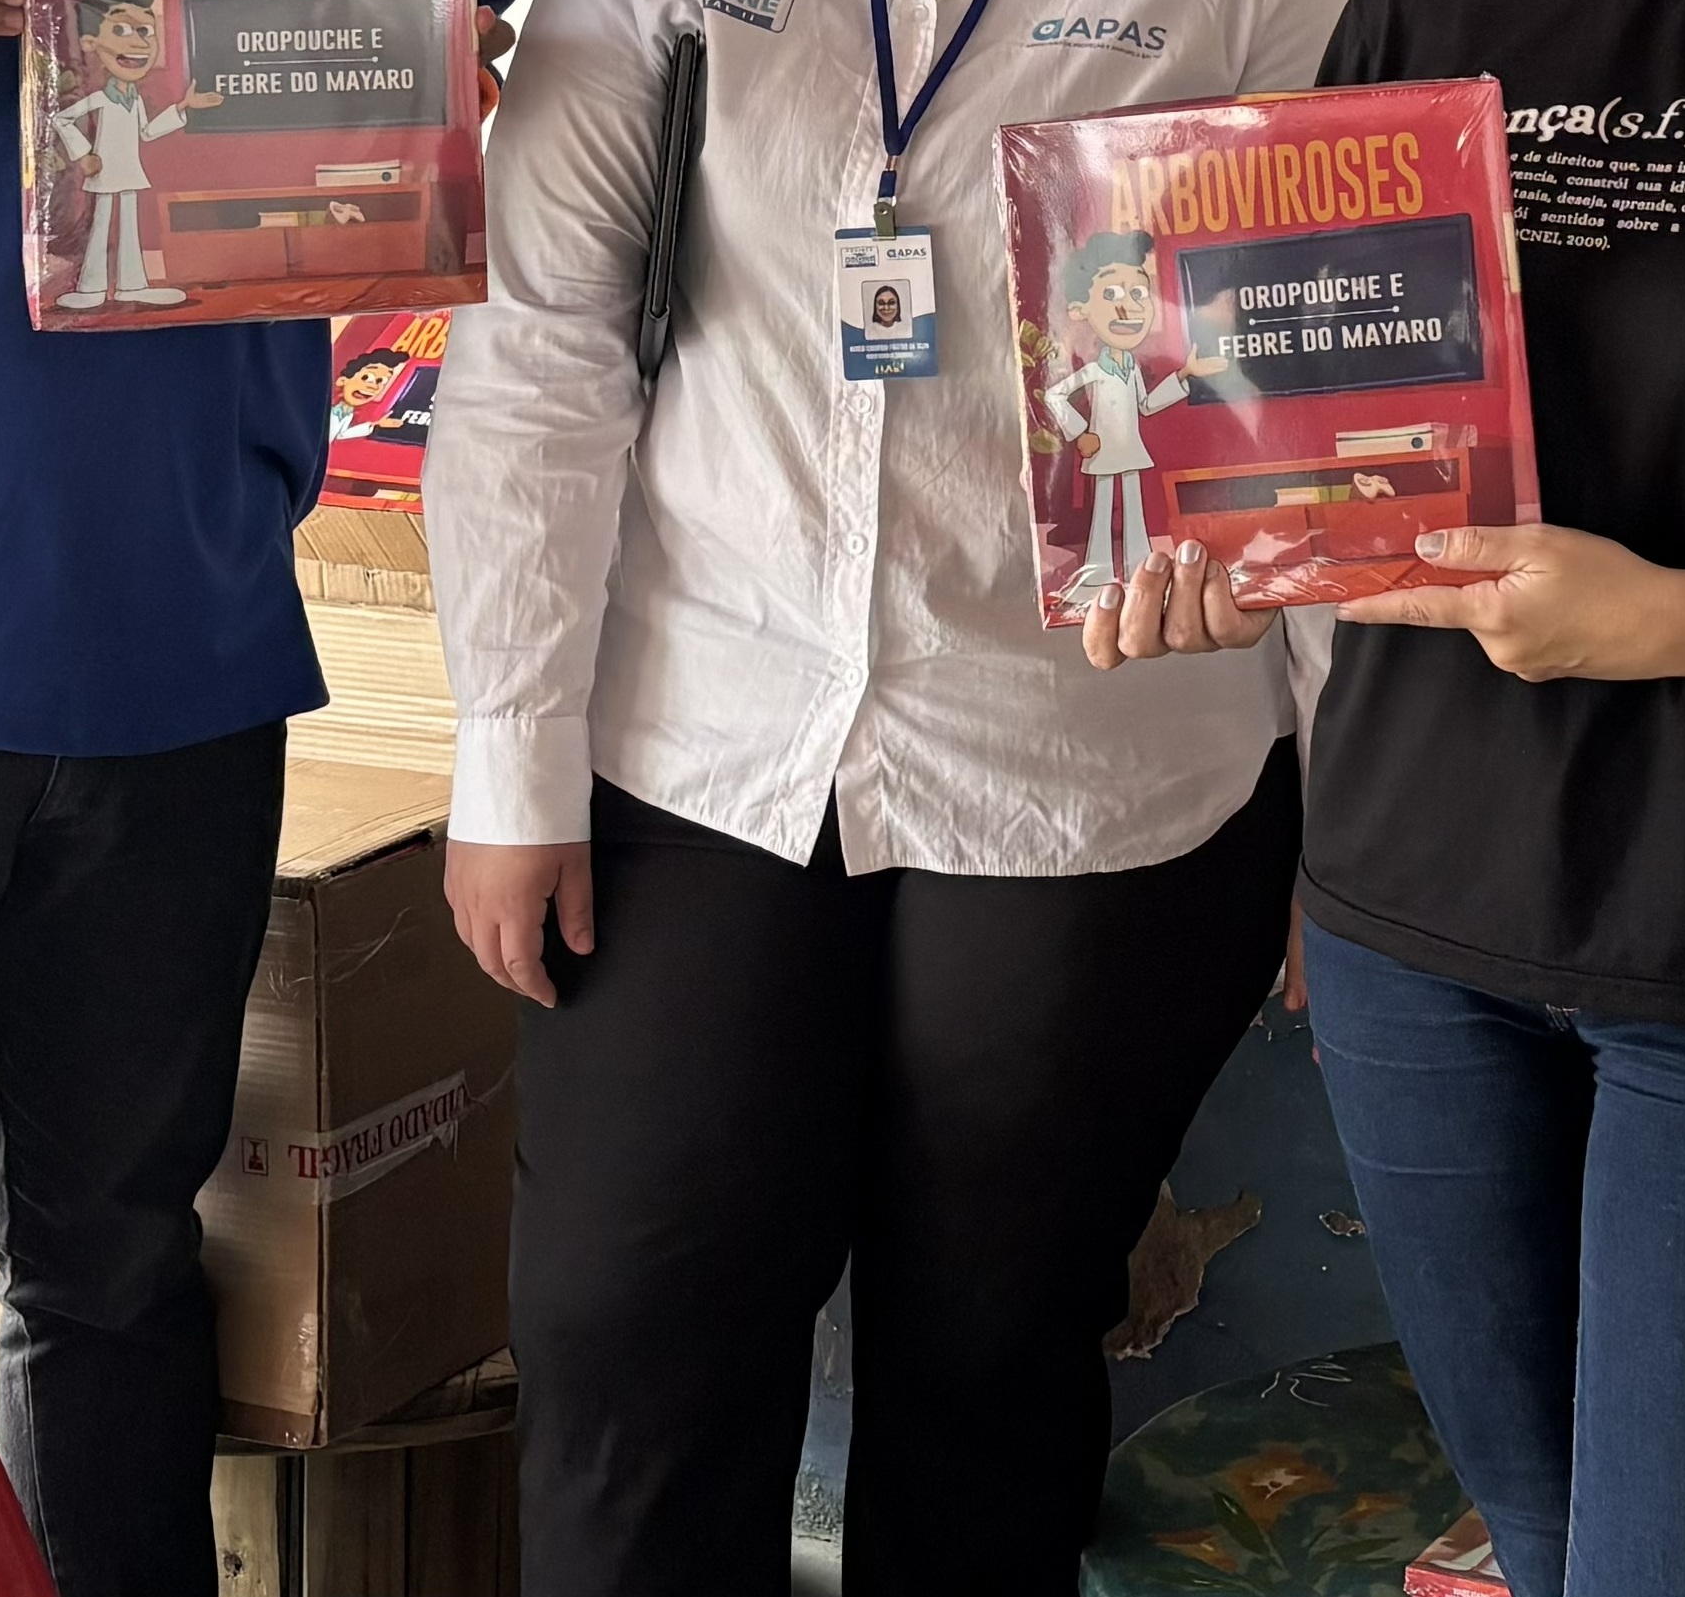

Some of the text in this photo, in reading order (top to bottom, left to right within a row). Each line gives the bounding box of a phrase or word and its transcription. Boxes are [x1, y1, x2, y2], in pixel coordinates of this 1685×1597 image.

[236, 28, 383, 54] OROPOUCHE E
[215, 68, 414, 96] FEBRE DO MAYARO
[1523, 151, 1541, 163] de
[1546, 152, 1604, 168] direitos
[1609, 161, 1640, 173] que,
[1647, 163, 1672, 173] nas
[1111, 132, 1424, 236] ARBOVIROSES
[1566, 176, 1628, 190] constrói
[1636, 182, 1662, 192] sua
[1557, 190, 1607, 209] deseja,
[1612, 197, 1677, 214] aprende,
[1540, 210, 1605, 227] sentidos
[1616, 216, 1659, 232] sobre
[1670, 223, 1680, 233] a
[1515, 228, 1611, 251] CNEI, 2009).
[1239, 272, 1404, 311] OROPOUCHE E
[1218, 317, 1443, 359] FEBRE DO MAYARO
